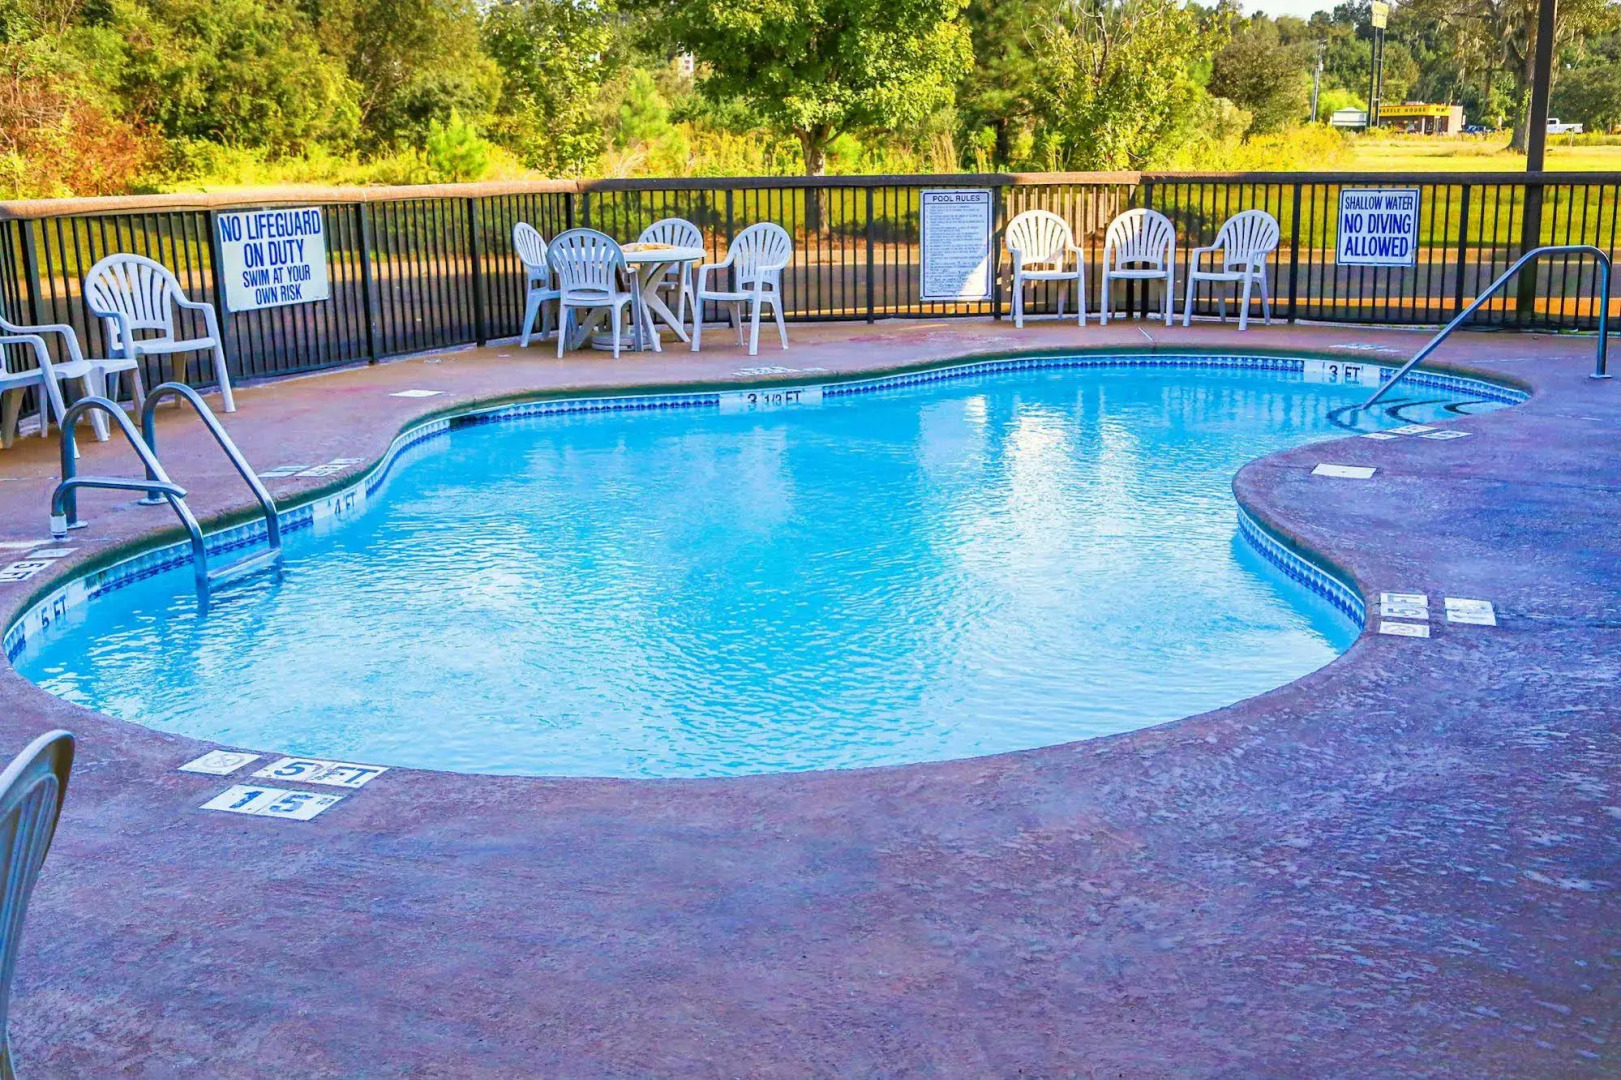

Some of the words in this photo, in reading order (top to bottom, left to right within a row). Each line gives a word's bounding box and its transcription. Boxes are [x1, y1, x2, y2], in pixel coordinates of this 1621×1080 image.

[1345, 196, 1383, 210] SHALLOW
[1385, 196, 1413, 210] WATER
[220, 215, 242, 242] NO
[246, 210, 321, 240] LIFEGUARD
[1344, 213, 1363, 234] NO
[1368, 213, 1411, 234] DIVING
[244, 242, 264, 268] ON
[268, 239, 304, 266] DUTY
[1344, 236, 1408, 257] ALLOWED
[242, 268, 270, 288] SWIM
[273, 267, 283, 284] AT
[287, 264, 311, 283] YOUR
[255, 286, 278, 305] OWN
[281, 283, 302, 302] RISK
[1329, 364, 1338, 376] 3
[1345, 366, 1361, 378] FT
[747, 393, 757, 403] 3
[785, 390, 801, 402] FT
[345, 492, 355, 510] FT
[41, 606, 50, 629] 5
[53, 594, 66, 620] FT
[273, 762, 317, 776] 5
